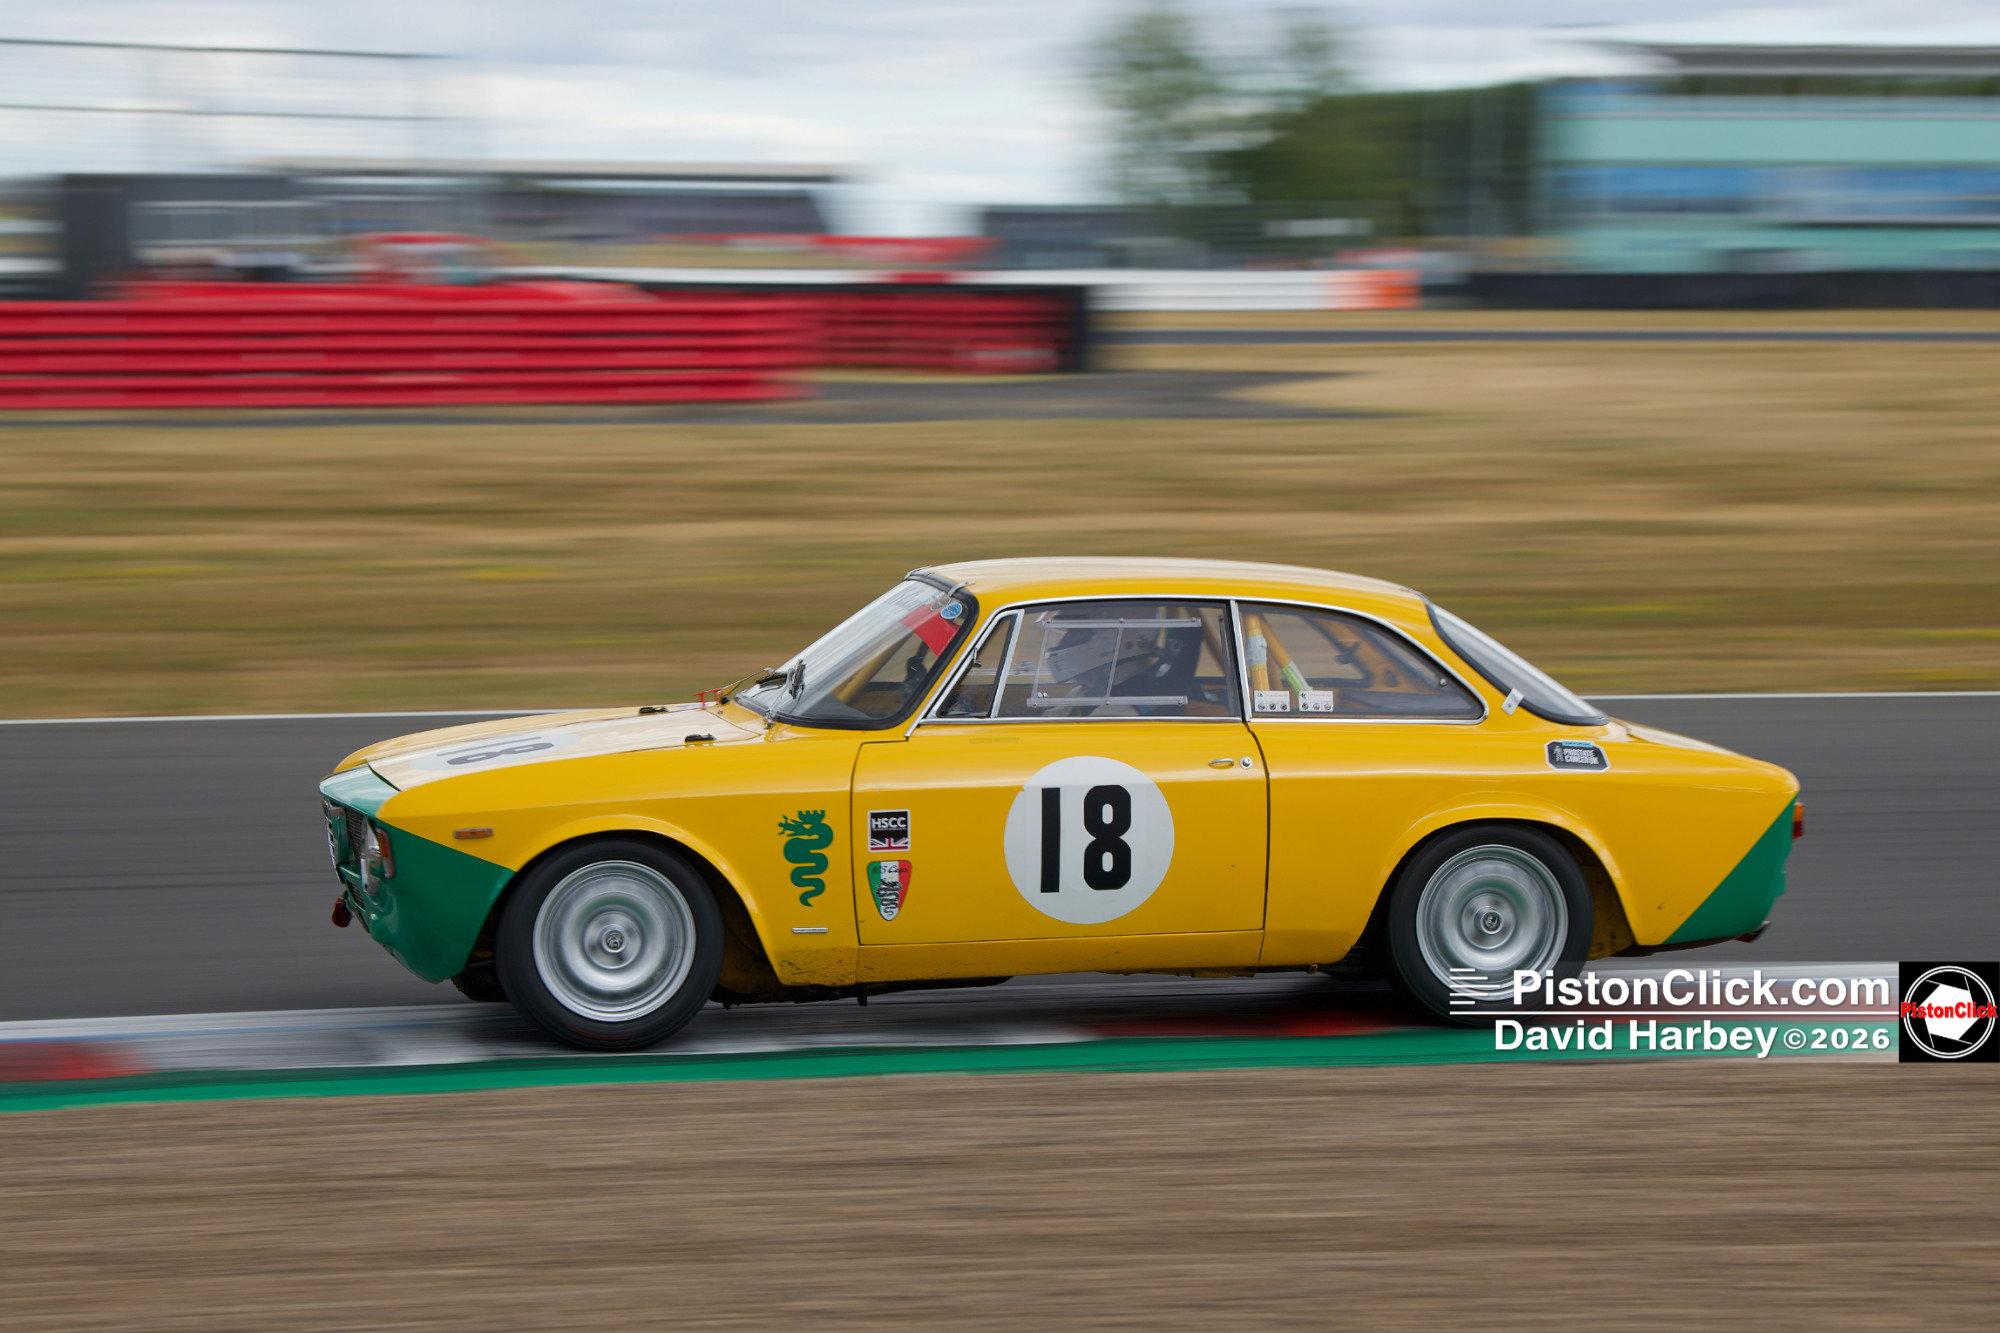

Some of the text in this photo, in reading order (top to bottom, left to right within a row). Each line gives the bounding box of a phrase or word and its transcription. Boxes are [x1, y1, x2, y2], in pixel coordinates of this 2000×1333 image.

[436, 736, 555, 765] 18
[871, 817, 907, 829] HSCC
[1040, 784, 1132, 893] 18
